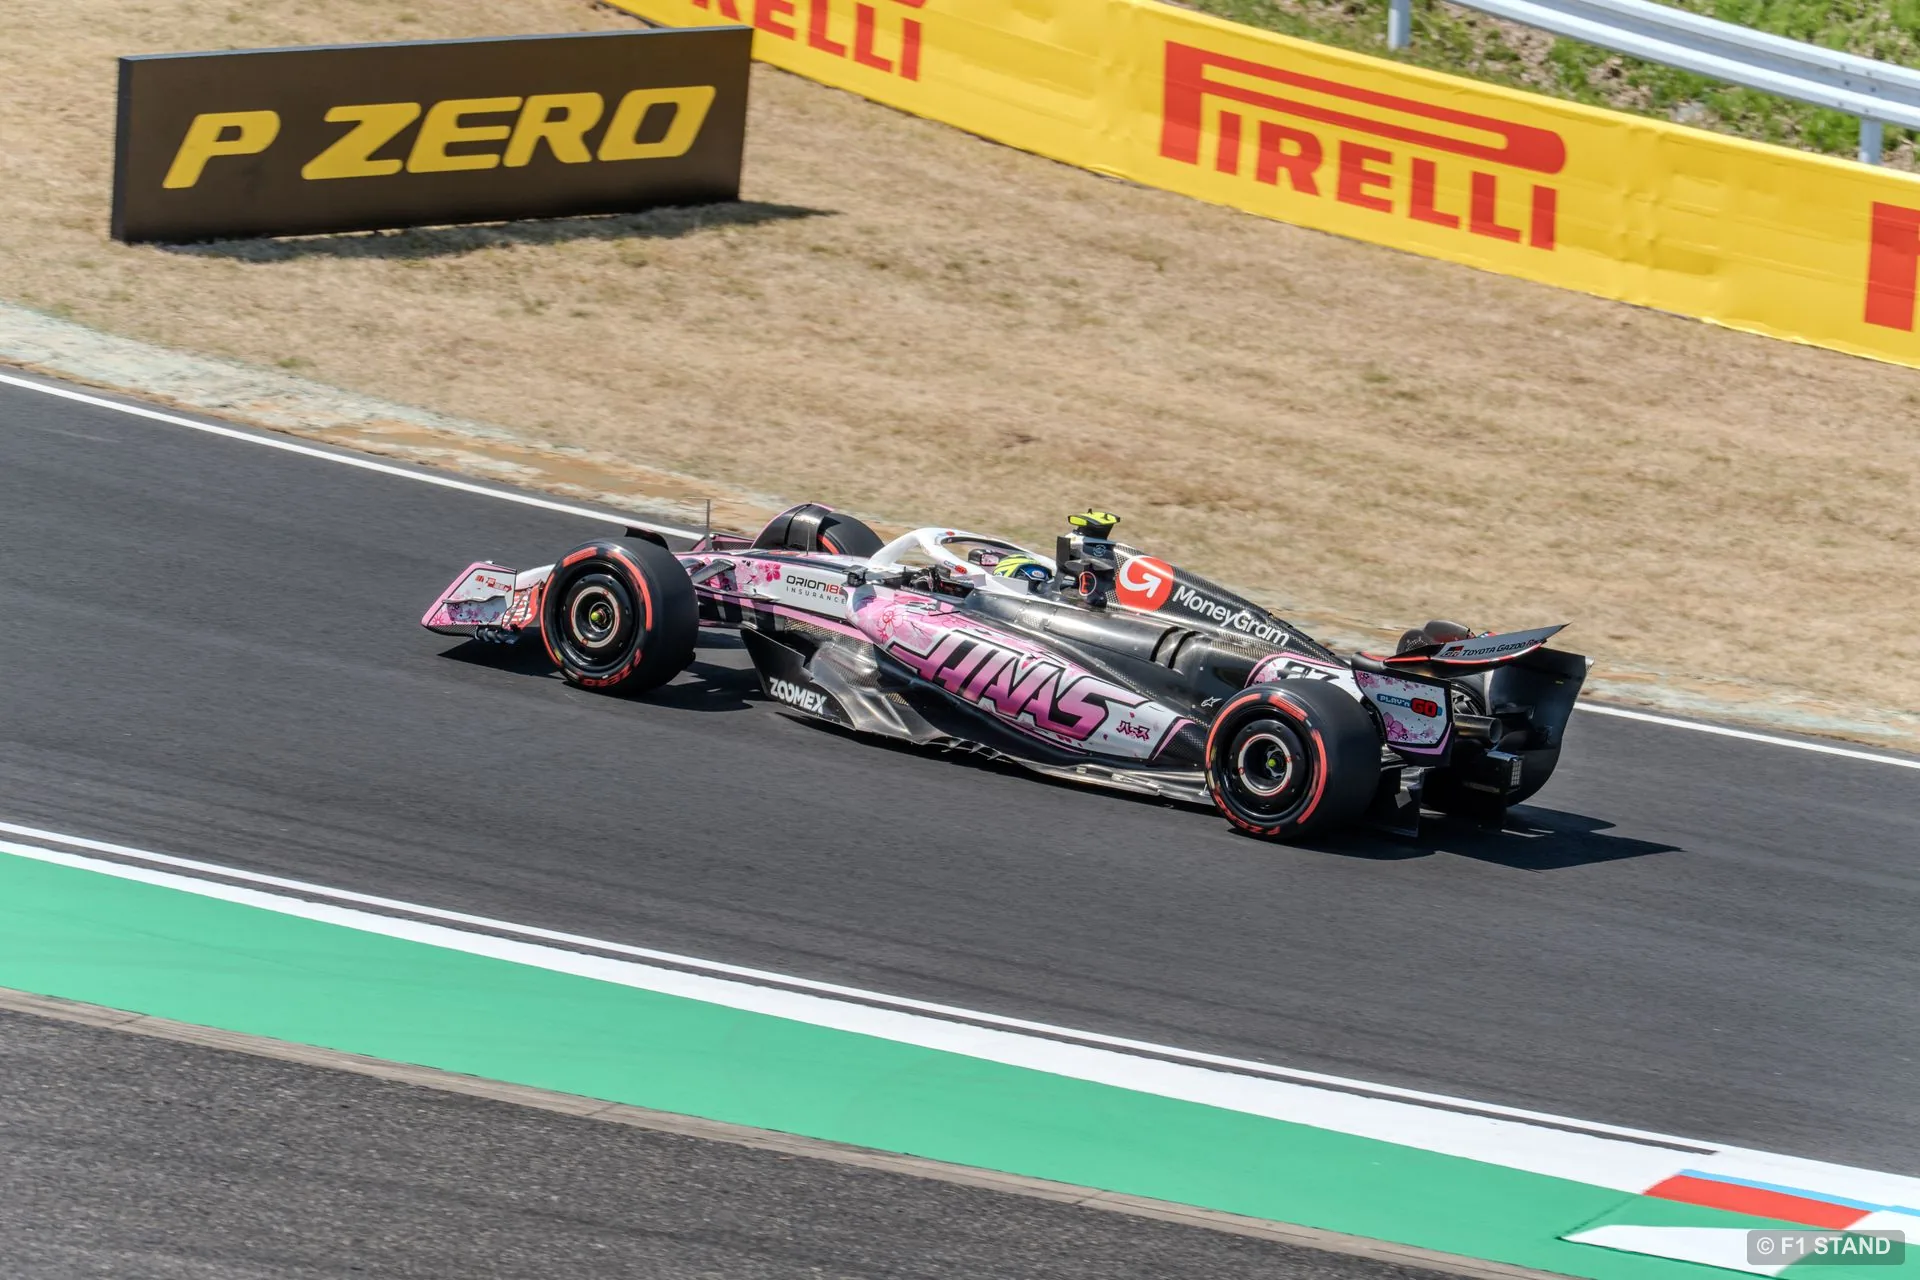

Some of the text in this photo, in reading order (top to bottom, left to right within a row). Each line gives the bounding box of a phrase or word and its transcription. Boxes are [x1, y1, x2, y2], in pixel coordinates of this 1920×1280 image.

[163, 85, 716, 189] P ZERO
[1159, 40, 1567, 252] PIRELLI
[786, 586, 848, 605] INSURANCE
[1172, 585, 1290, 646] MoneyGram
[1462, 646, 1496, 657] TOYOTA
[769, 676, 828, 715] ZOOMEX
[1411, 698, 1437, 718] GO
